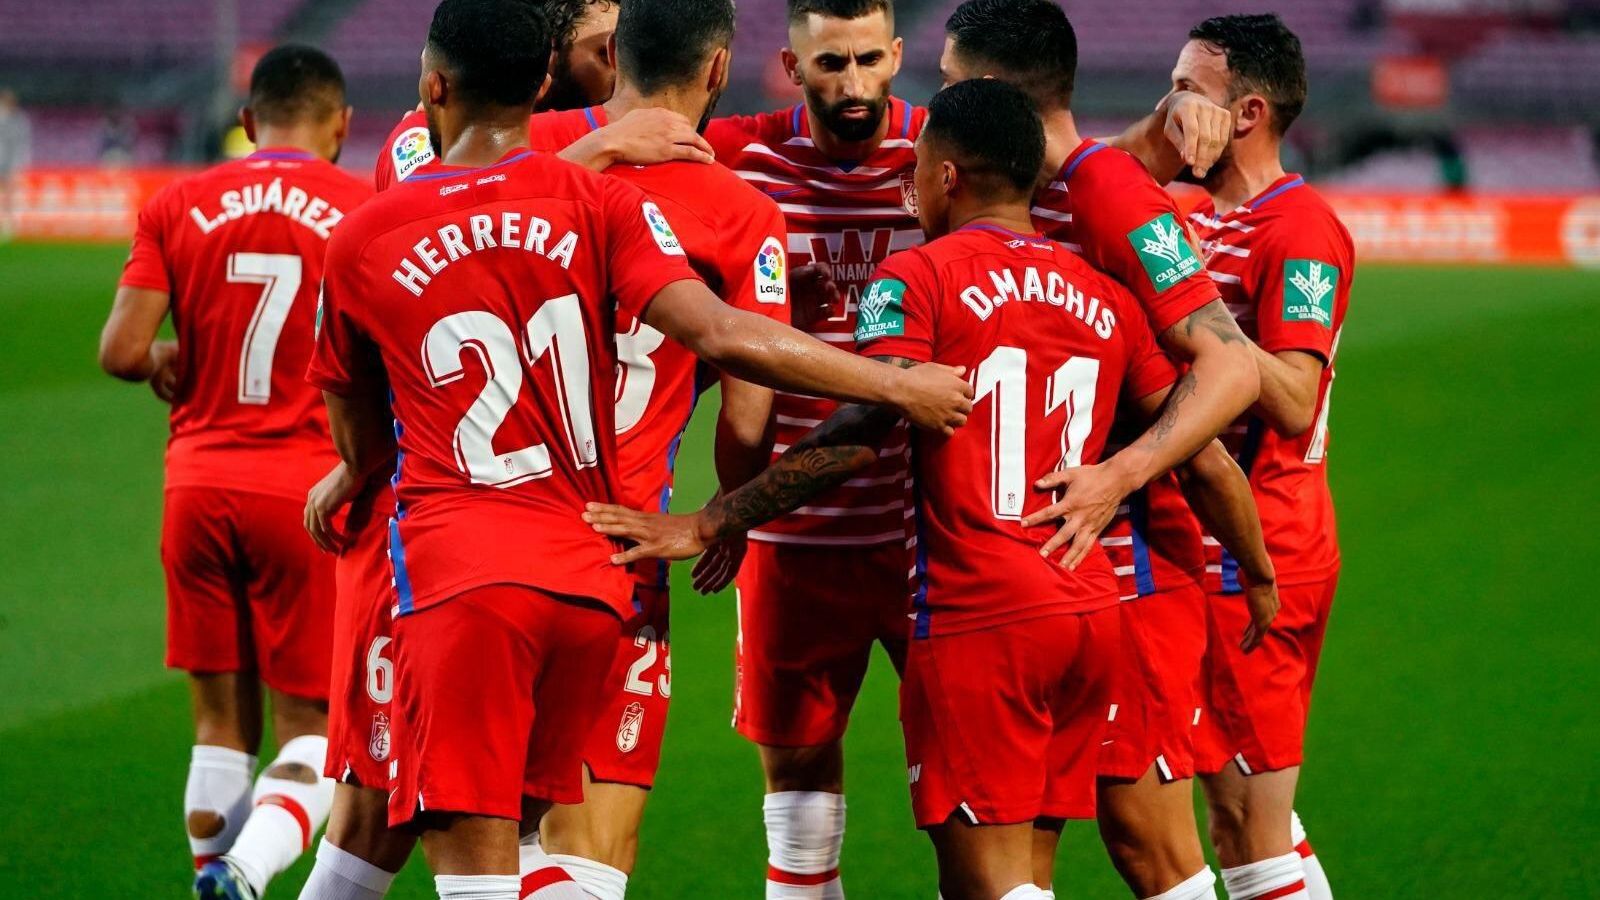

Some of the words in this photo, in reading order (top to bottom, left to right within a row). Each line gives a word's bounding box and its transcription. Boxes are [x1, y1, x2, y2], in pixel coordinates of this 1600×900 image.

[400, 152, 431, 174] LaLiga
[190, 177, 344, 239] L.SUÁREZ
[392, 211, 579, 297] HERRERA
[831, 263, 877, 280] INAMA
[1155, 268, 1178, 283] CAJA
[759, 284, 784, 296] LaLiga
[959, 266, 1116, 340] D.MACHIS
[1287, 305, 1309, 314] CAJA
[226, 252, 303, 405] 7
[868, 320, 900, 332] RURAL
[420, 293, 599, 489] 21
[968, 345, 1100, 522] 11
[366, 635, 393, 704] 6
